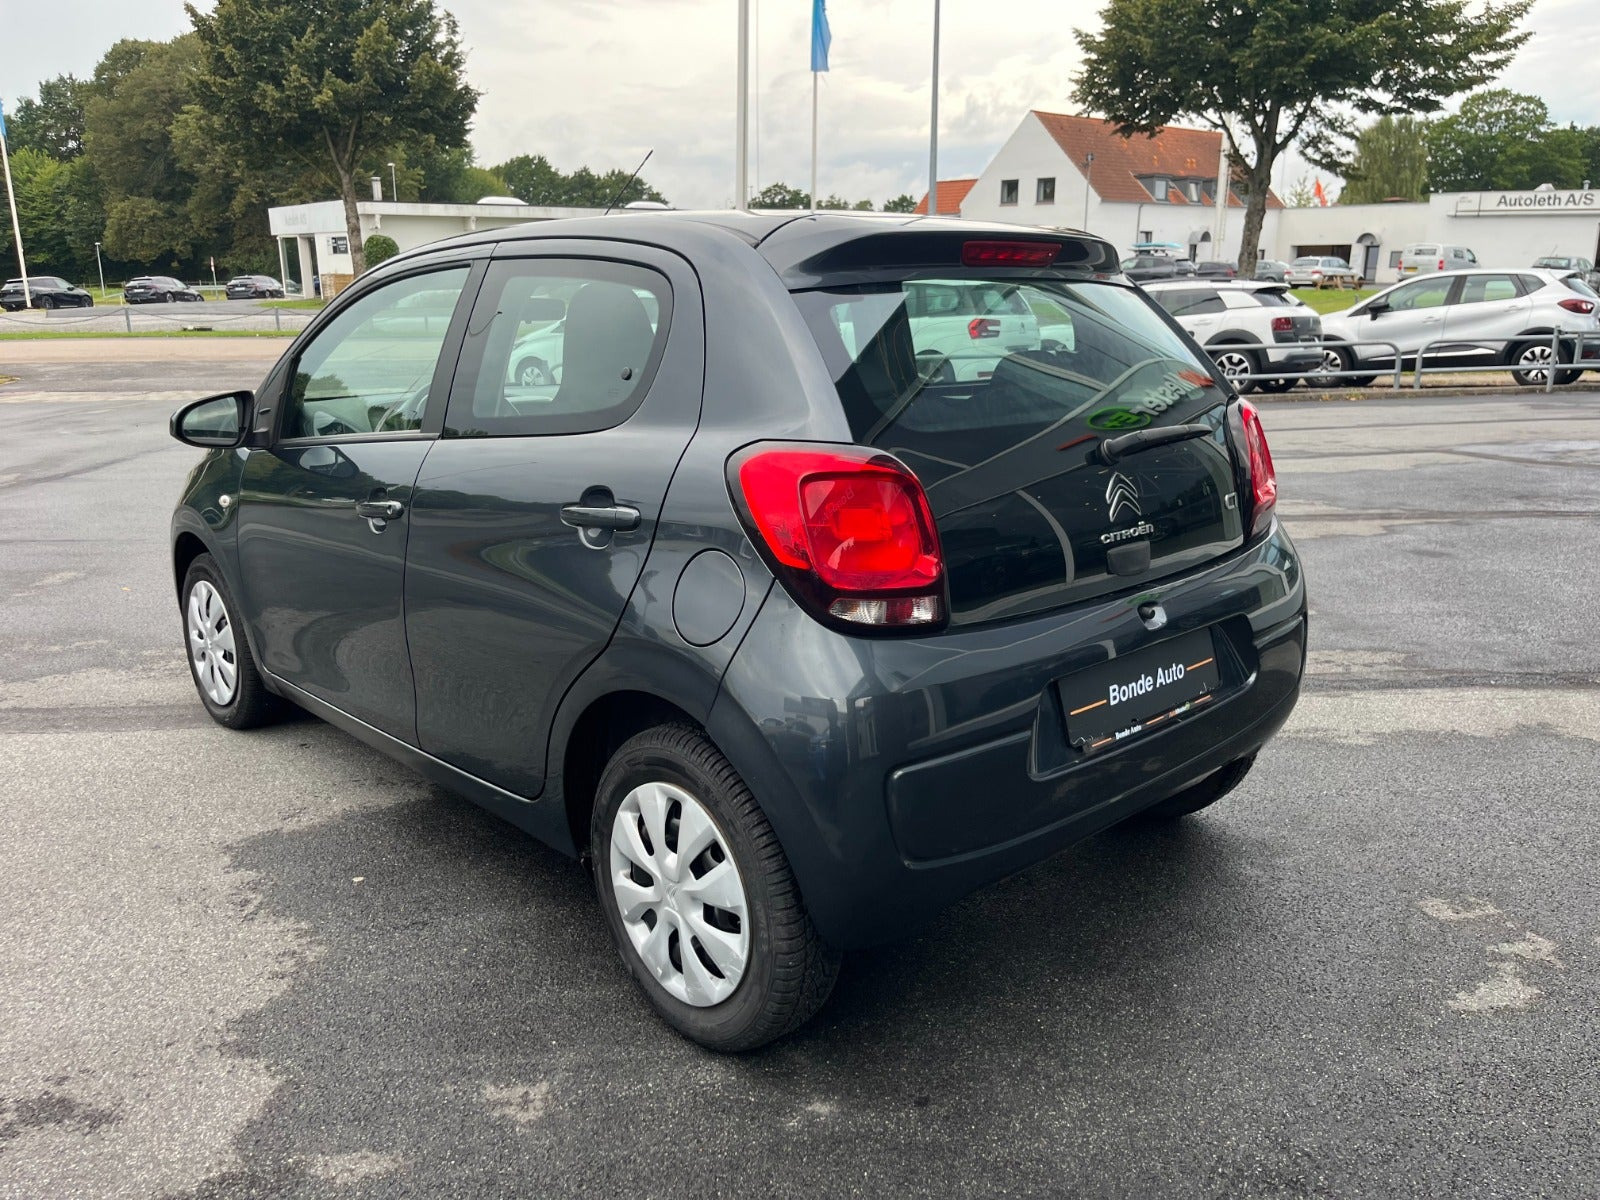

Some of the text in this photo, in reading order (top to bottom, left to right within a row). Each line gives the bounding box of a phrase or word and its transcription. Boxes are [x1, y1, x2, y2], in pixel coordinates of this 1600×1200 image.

[1497, 193, 1594, 207] Autoleth A/S
[1109, 662, 1185, 706] Bonde Auto
